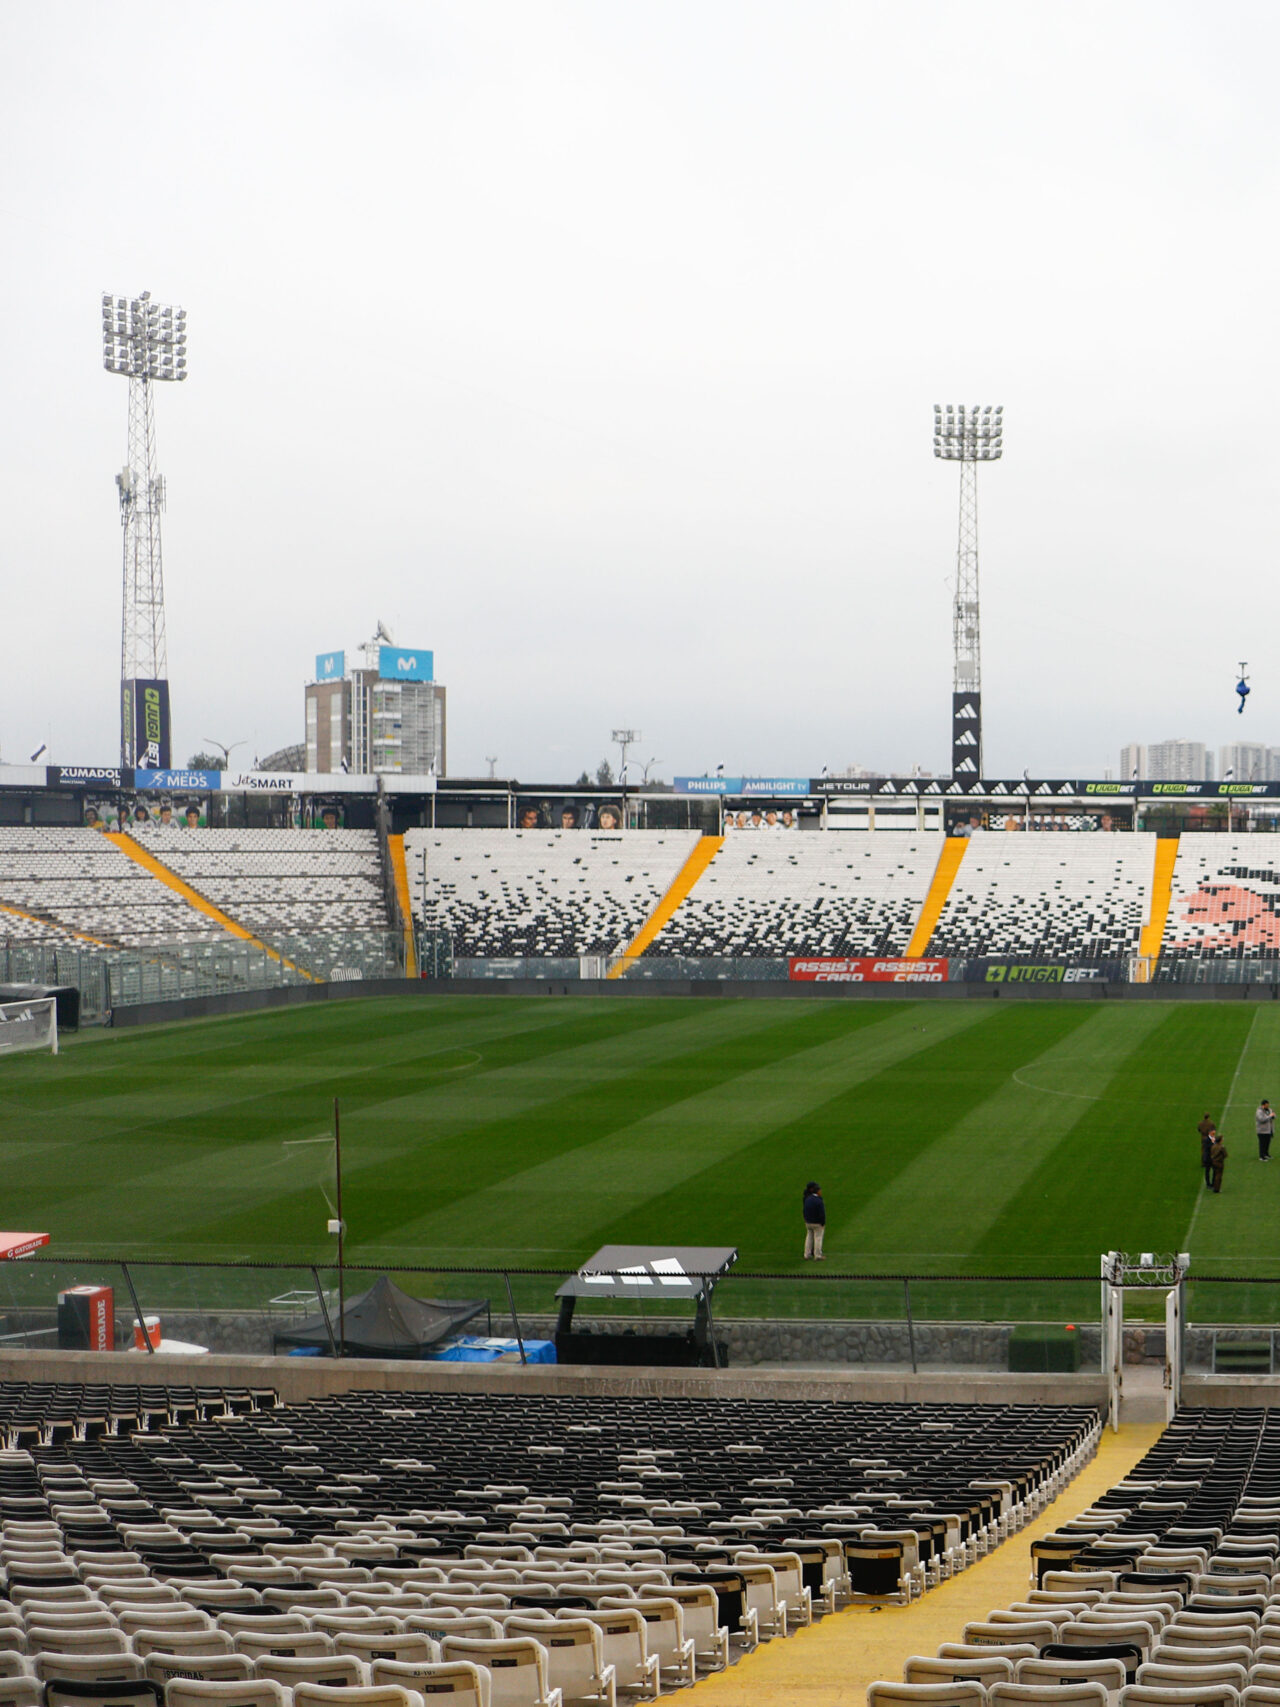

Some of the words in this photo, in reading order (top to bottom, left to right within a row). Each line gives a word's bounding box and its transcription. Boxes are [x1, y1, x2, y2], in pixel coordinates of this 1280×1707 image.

[60, 768, 121, 778] XUMADOL
[167, 776, 207, 787] MEDS
[688, 781, 727, 790] PHILIPS
[745, 782, 796, 791] AMBILIGHT
[794, 962, 860, 972] ASSIST
[873, 962, 939, 972] ASSIST
[815, 973, 864, 981] CARD
[894, 973, 943, 981] CARD
